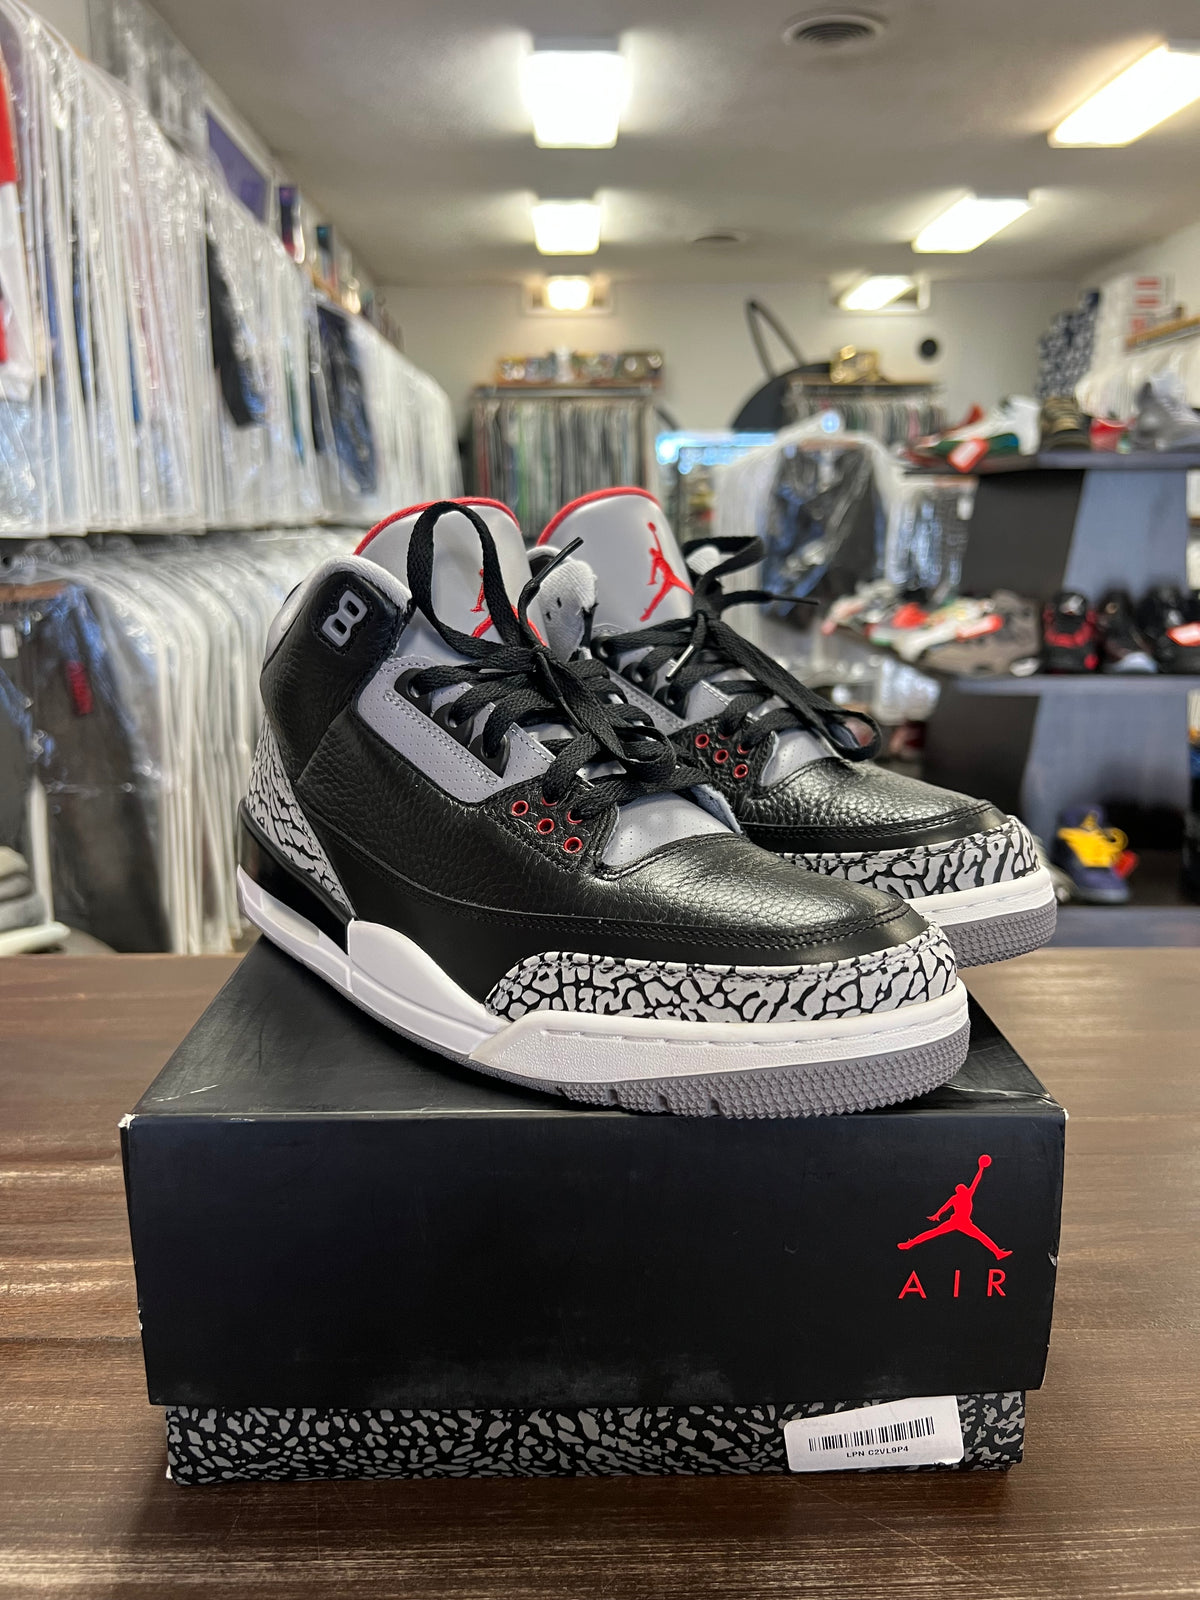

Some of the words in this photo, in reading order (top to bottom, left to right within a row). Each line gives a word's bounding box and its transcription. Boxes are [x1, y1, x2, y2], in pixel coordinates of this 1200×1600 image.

[898, 1268, 1006, 1299] AIR
[846, 1450, 865, 1458] LPN
[868, 1445, 909, 1456] C2VL9P4
